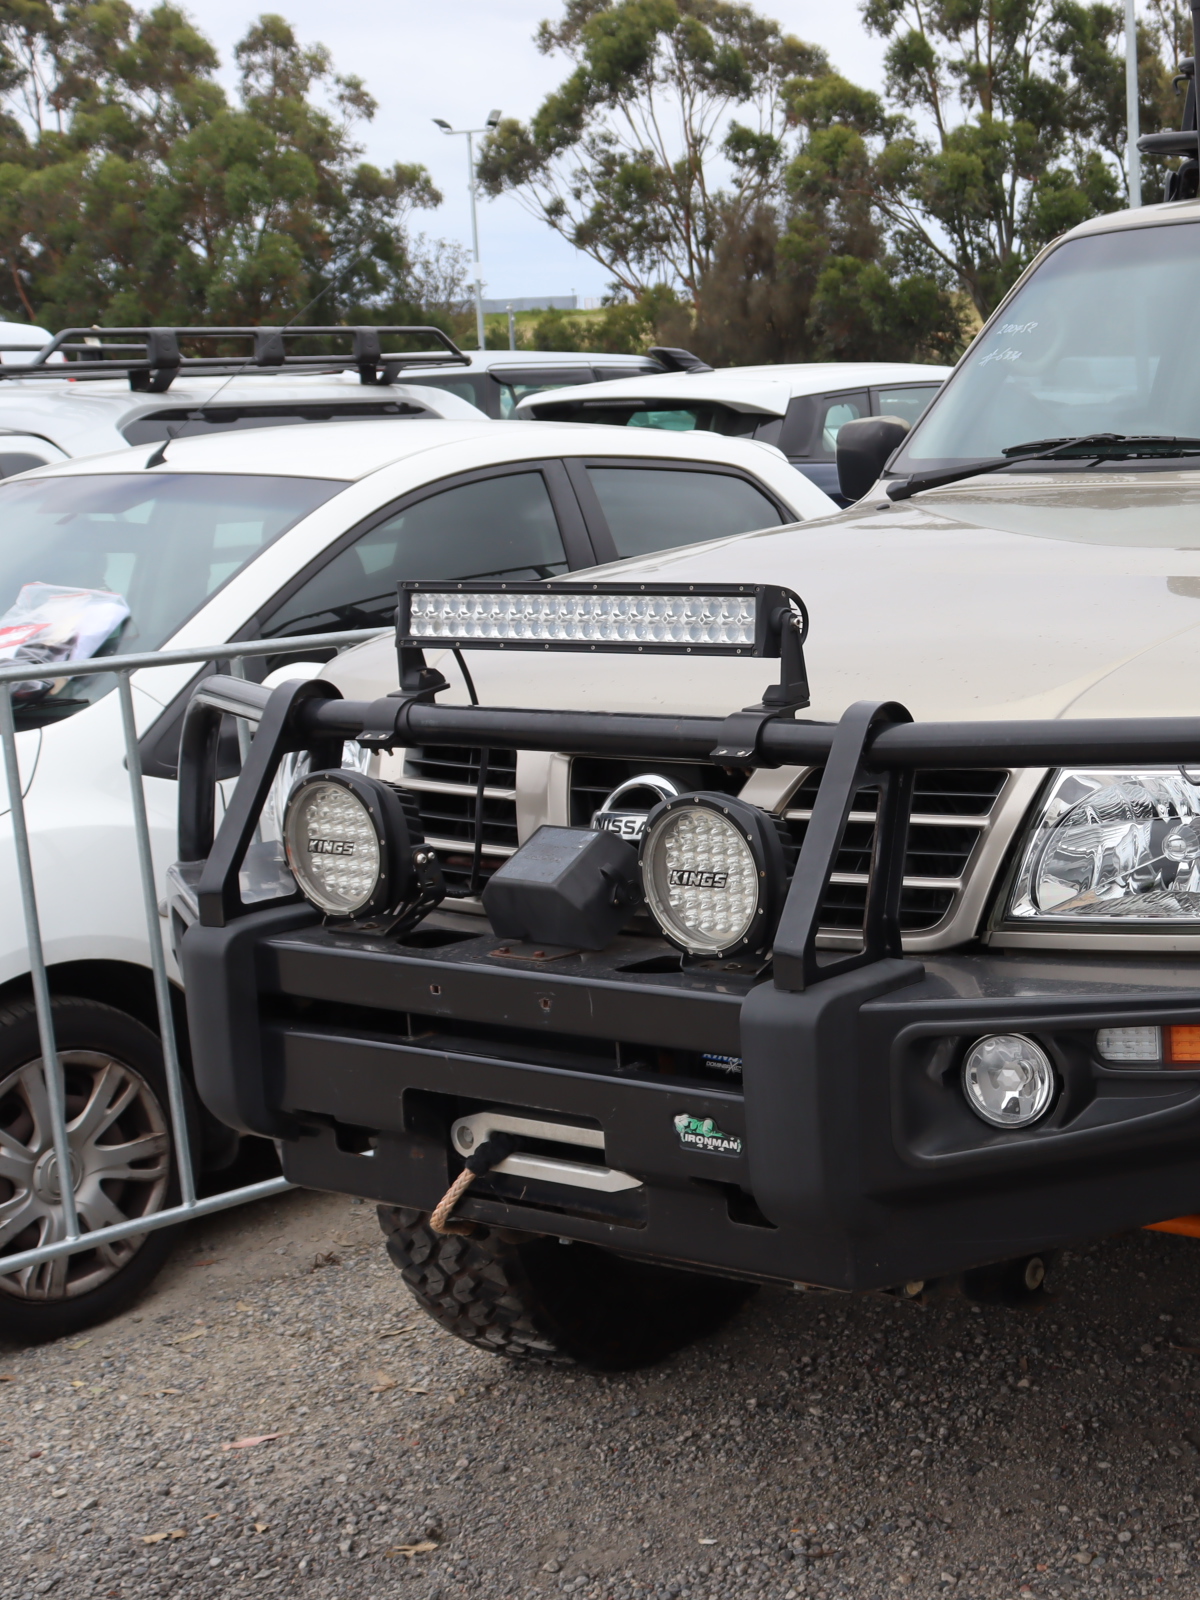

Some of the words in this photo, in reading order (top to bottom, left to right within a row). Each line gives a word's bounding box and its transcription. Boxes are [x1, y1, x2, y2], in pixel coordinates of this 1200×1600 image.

[594, 817, 646, 836] NISSA
[308, 839, 354, 856] KINGS
[670, 870, 728, 888] KINGS
[684, 1133, 738, 1150] IRONMAN
